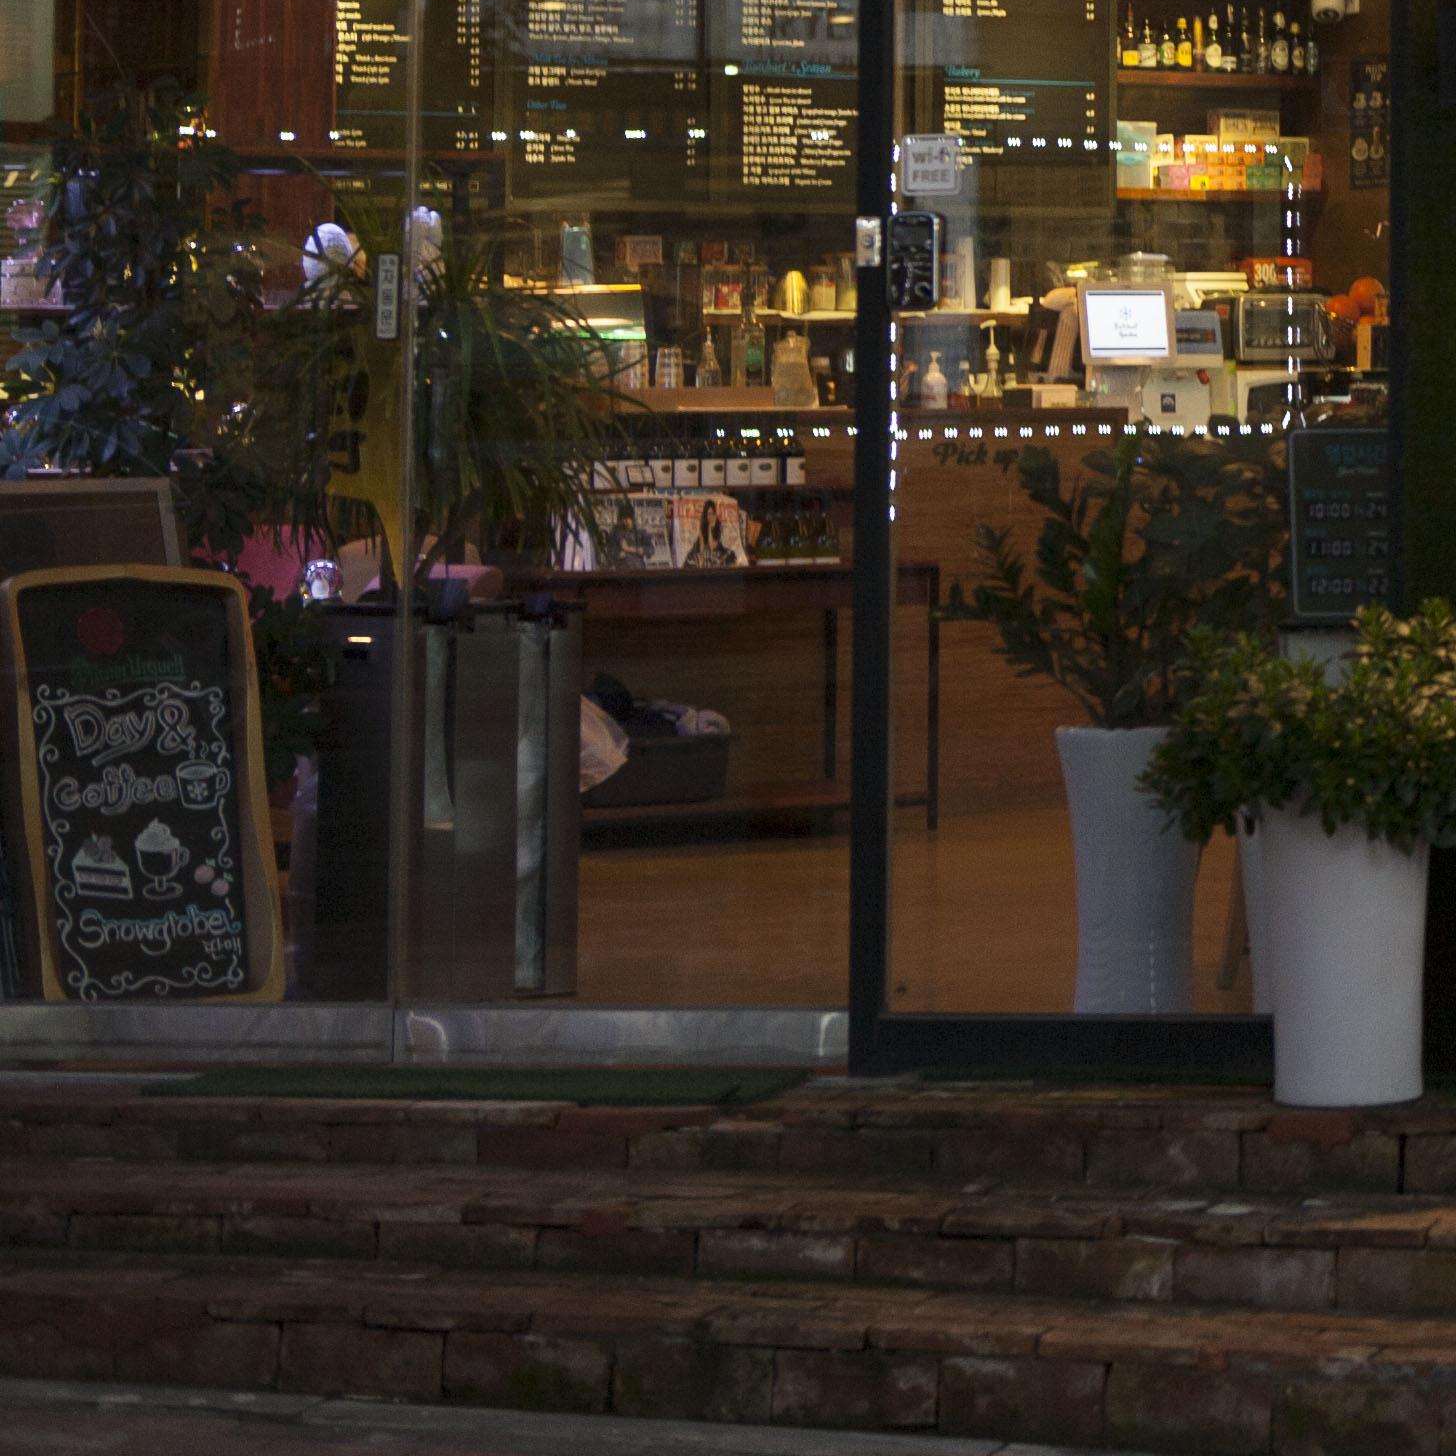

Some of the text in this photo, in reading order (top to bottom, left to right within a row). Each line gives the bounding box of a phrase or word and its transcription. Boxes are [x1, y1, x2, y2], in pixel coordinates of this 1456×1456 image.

[912, 169, 950, 183] FREE
[933, 443, 987, 466] Pick
[64, 698, 196, 766] Day &
[77, 905, 233, 957] Snowglobe
